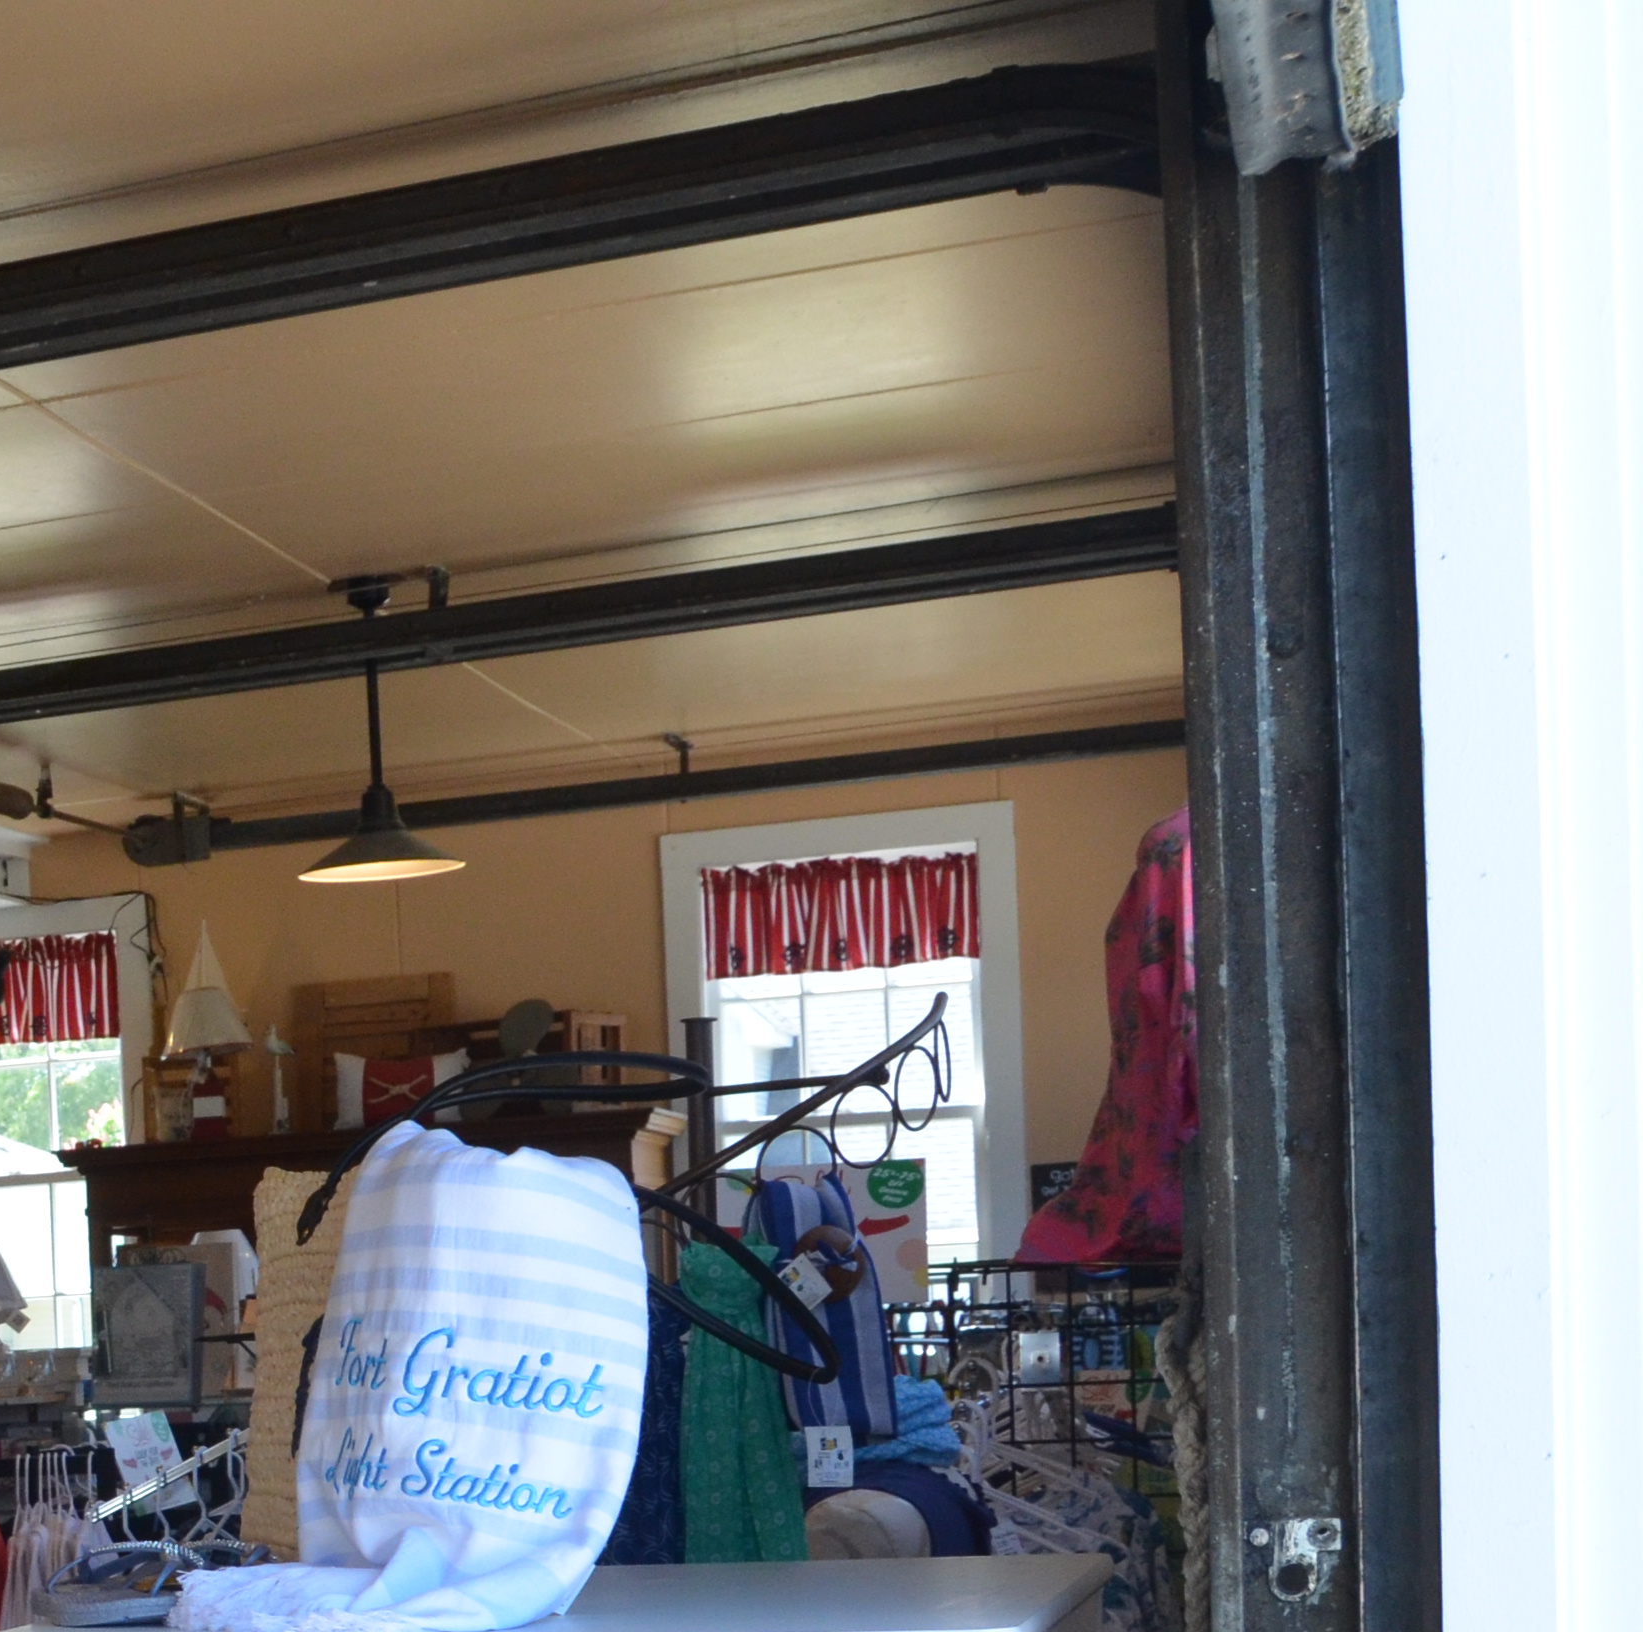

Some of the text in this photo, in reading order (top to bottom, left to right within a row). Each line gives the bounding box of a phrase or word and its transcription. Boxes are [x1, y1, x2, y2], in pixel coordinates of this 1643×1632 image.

[335, 1319, 605, 1418] Fort Gratiot
[325, 1427, 572, 1519] Light Station
